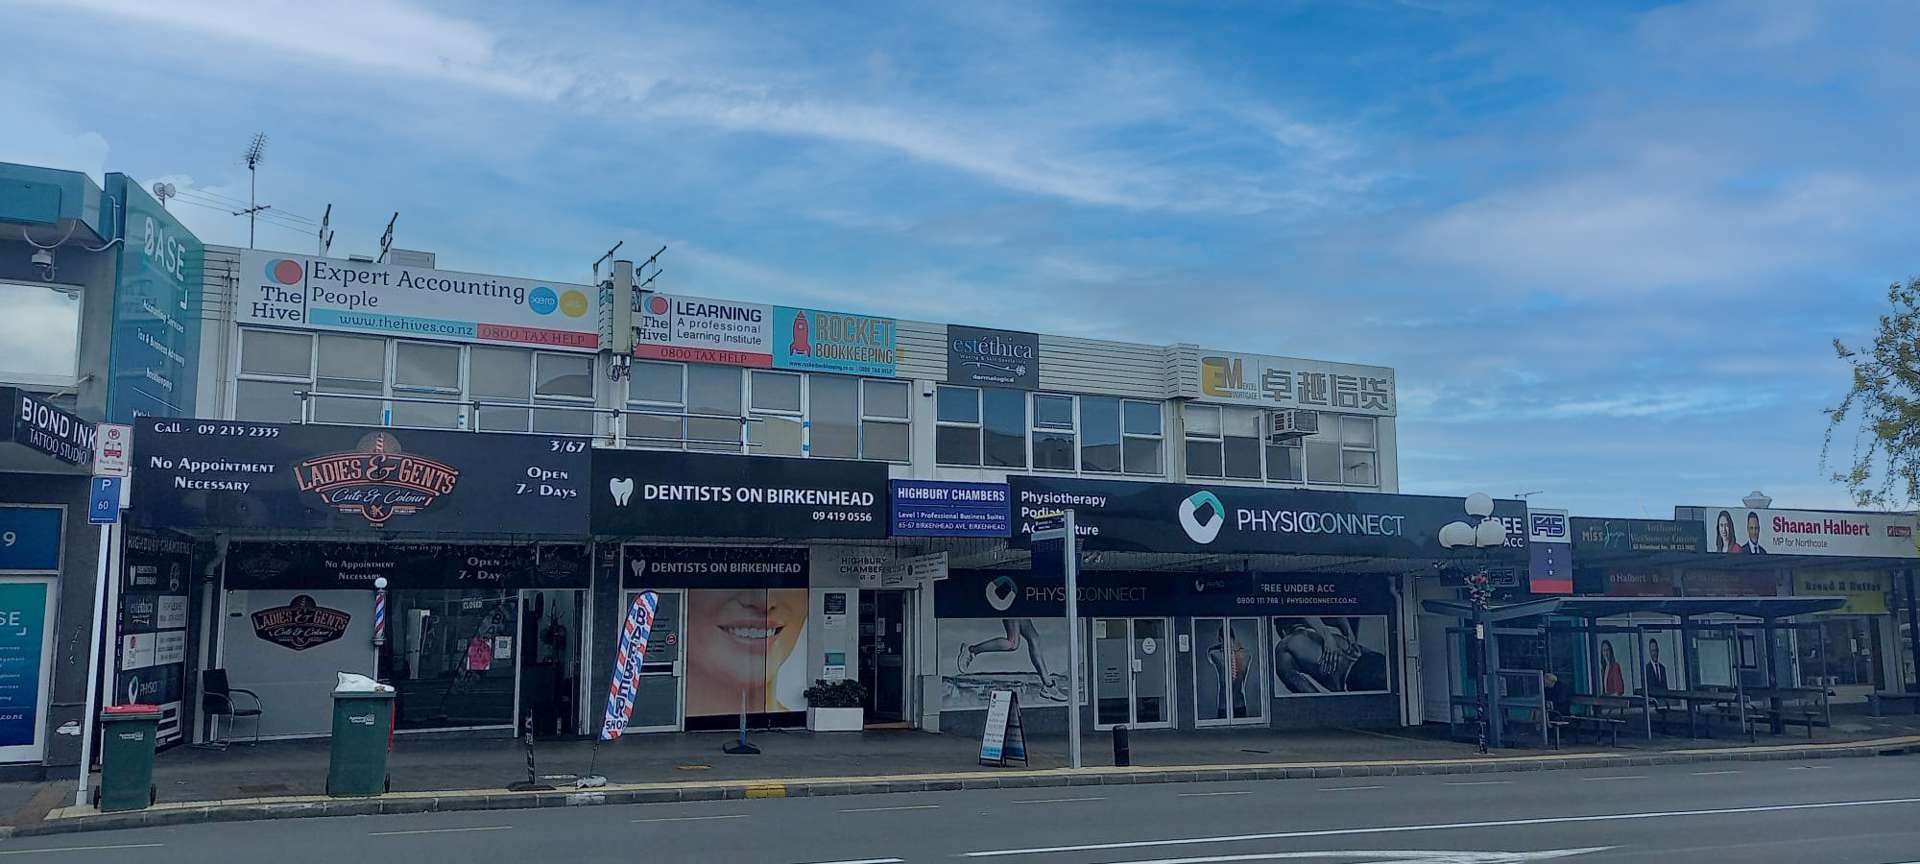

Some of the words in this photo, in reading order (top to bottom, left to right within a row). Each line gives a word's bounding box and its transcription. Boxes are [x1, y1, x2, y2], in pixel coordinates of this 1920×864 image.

[313, 262, 390, 286] Expert
[397, 271, 525, 304] Accounting
[261, 286, 302, 303] The
[312, 286, 378, 310] People
[251, 302, 301, 321] Hive
[677, 301, 761, 322] LEARNING
[339, 313, 473, 336] www.thehives.co.nz
[642, 316, 669, 329] The
[678, 319, 685, 327] A
[689, 320, 761, 334] professional
[482, 327, 518, 341] 0800
[524, 331, 551, 343] TAX
[553, 333, 585, 345] HELP
[639, 328, 668, 342] Hive
[677, 330, 720, 343] Learning
[723, 334, 761, 345] Institute
[815, 313, 892, 348] ROCKET
[816, 343, 893, 364] BOOKKEEPING
[953, 336, 1032, 358] estéthica
[660, 348, 690, 359] 0800
[694, 350, 715, 361] TAX
[719, 352, 747, 363] HELP
[22, 397, 69, 438] BIOND
[73, 422, 96, 450] INK
[155, 422, 182, 434] Call
[198, 424, 215, 435] 09
[218, 425, 244, 437] 215
[248, 427, 280, 438] 2335
[30, 428, 59, 453] TATTOO
[60, 443, 87, 465] STUDIO
[550, 441, 585, 453] 3/67
[151, 457, 172, 470] No
[294, 459, 361, 491] LADIES
[366, 454, 396, 481] &
[399, 458, 456, 494] GENTS
[102, 479, 111, 491] P
[331, 488, 362, 503] Cuts
[384, 490, 425, 503] Colour
[644, 484, 731, 501] DENTISTS
[736, 487, 764, 503] ON
[767, 488, 874, 506] BIRKENHEAD
[897, 488, 948, 500] HIGHBURY
[951, 490, 1005, 501] CHAMBERS
[1021, 491, 1106, 507] Physiotherapy
[98, 501, 108, 510] 60
[812, 511, 826, 521] 09
[827, 511, 846, 521] 419
[847, 512, 872, 522] 0556
[921, 512, 958, 520] Professional
[1531, 513, 1566, 536] F45
[1773, 516, 1821, 533] Shanan
[1824, 519, 1869, 536] Halbert
[3, 531, 17, 547] 9
[1503, 538, 1524, 548] ACC
[1773, 537, 1784, 547] MP
[1785, 537, 1793, 547] for
[1795, 538, 1828, 548] Northcote
[325, 560, 337, 568] No
[651, 562, 707, 573] DENTISTS
[710, 563, 727, 573] ON
[730, 563, 801, 573] BIRKENHEAD
[841, 557, 887, 565] HIGHBURY
[1026, 586, 1147, 601] PHYSCONNECT
[1284, 584, 1314, 593] UNDER
[1318, 584, 1335, 593] ACC
[253, 612, 292, 630] LADIES
[314, 611, 347, 630] GENTS
[614, 607, 646, 718] BARBER
[605, 720, 627, 730] SHOP
